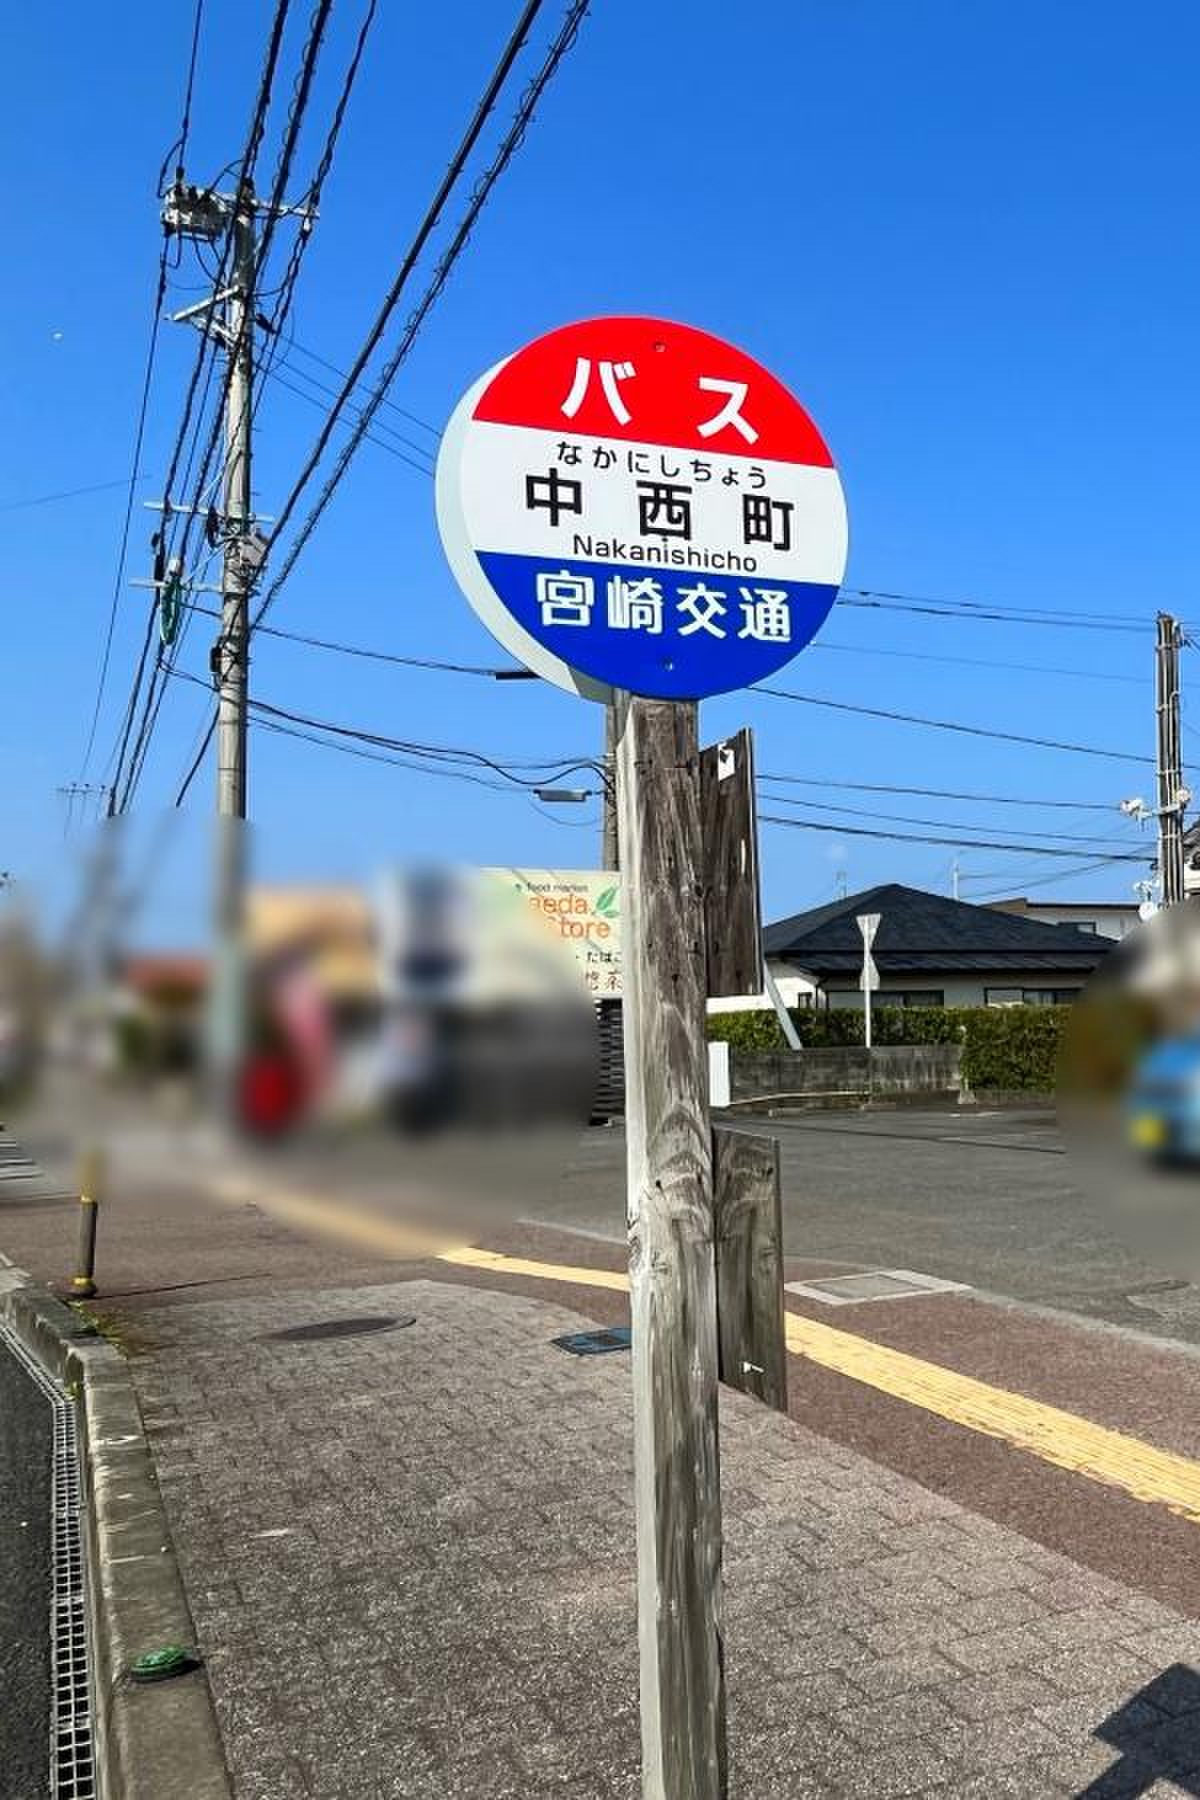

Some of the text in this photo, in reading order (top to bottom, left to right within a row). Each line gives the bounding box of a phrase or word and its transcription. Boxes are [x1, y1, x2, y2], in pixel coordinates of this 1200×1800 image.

[560, 357, 759, 445] バス
[556, 440, 768, 489] なかにしちょう
[525, 467, 795, 551] 中西町
[573, 534, 758, 573] Nakanishicho
[536, 569, 792, 643] 宮崎交通
